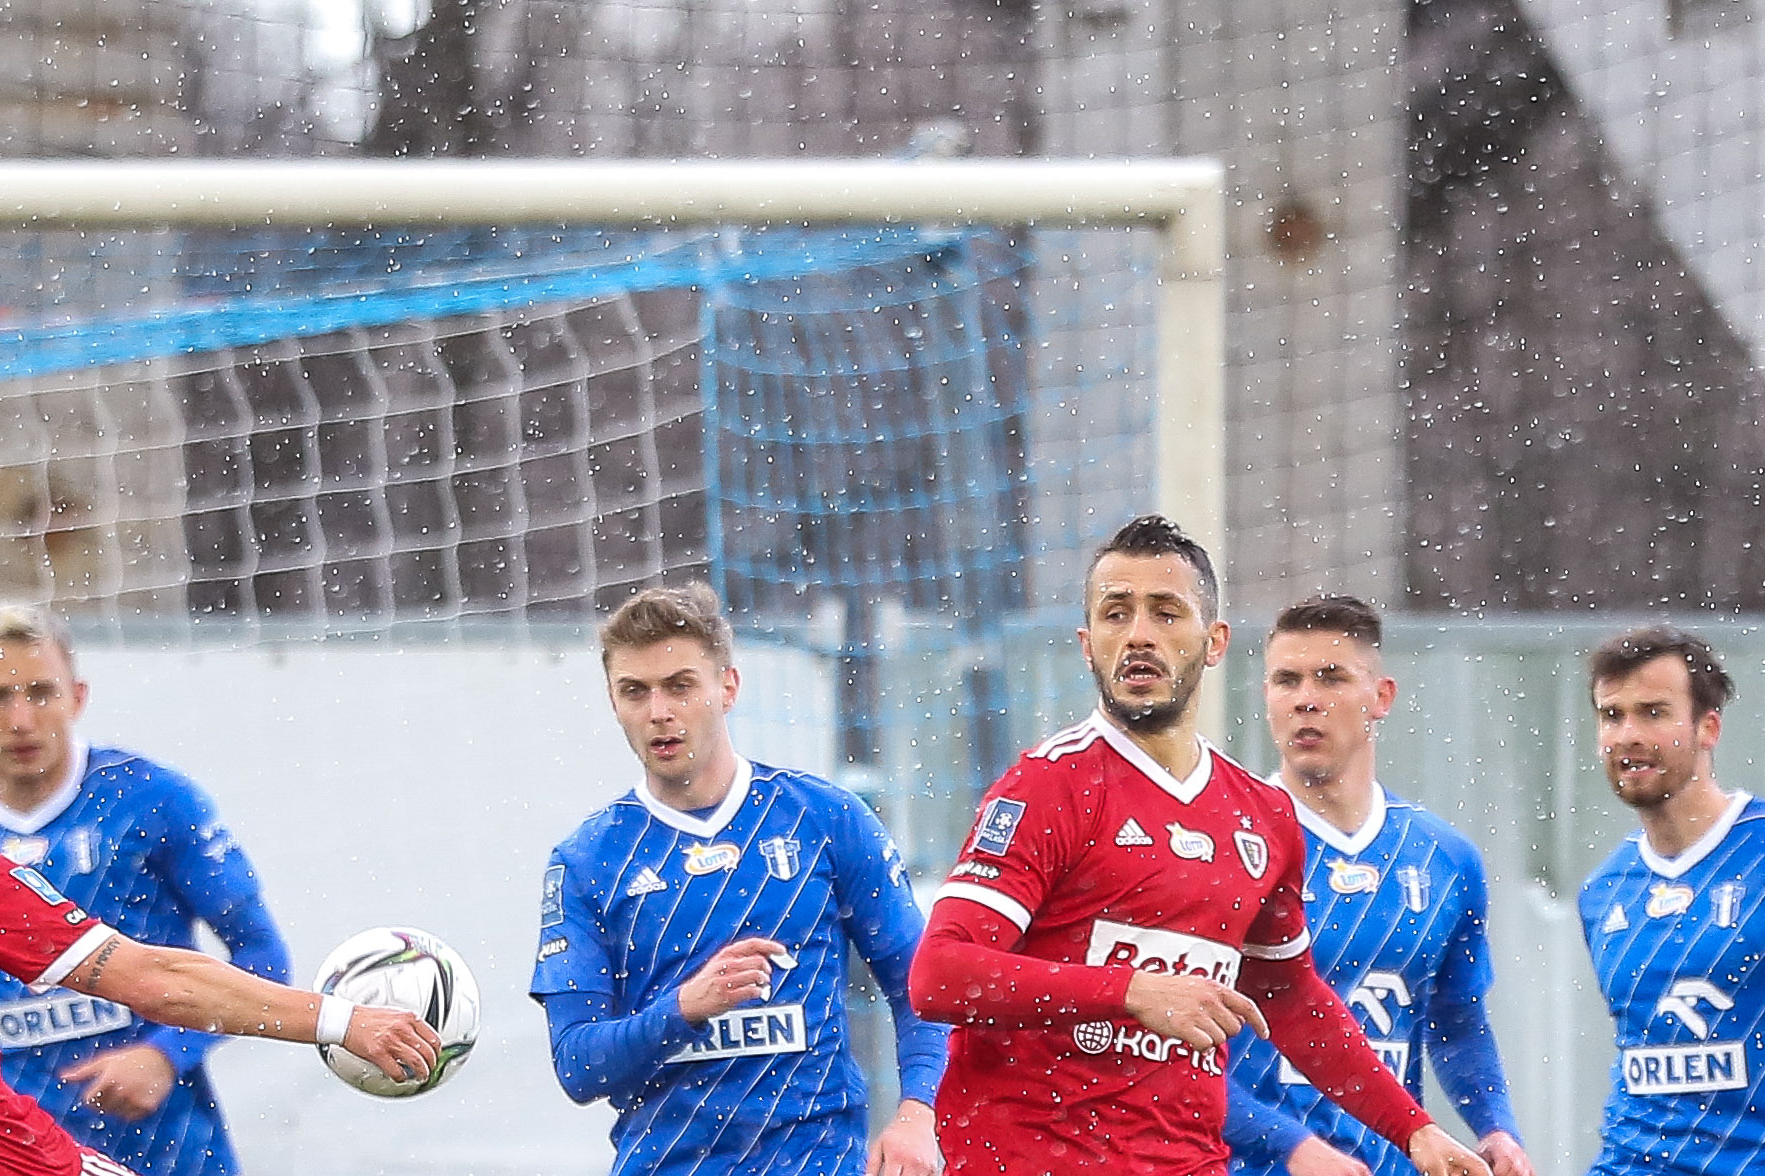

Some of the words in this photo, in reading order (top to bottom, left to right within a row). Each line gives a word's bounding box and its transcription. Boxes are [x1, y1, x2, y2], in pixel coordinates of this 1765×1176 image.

[0, 999, 116, 1037] ORLEN
[690, 1013, 796, 1053] RLEN
[1629, 1051, 1734, 1086] ORLEN
